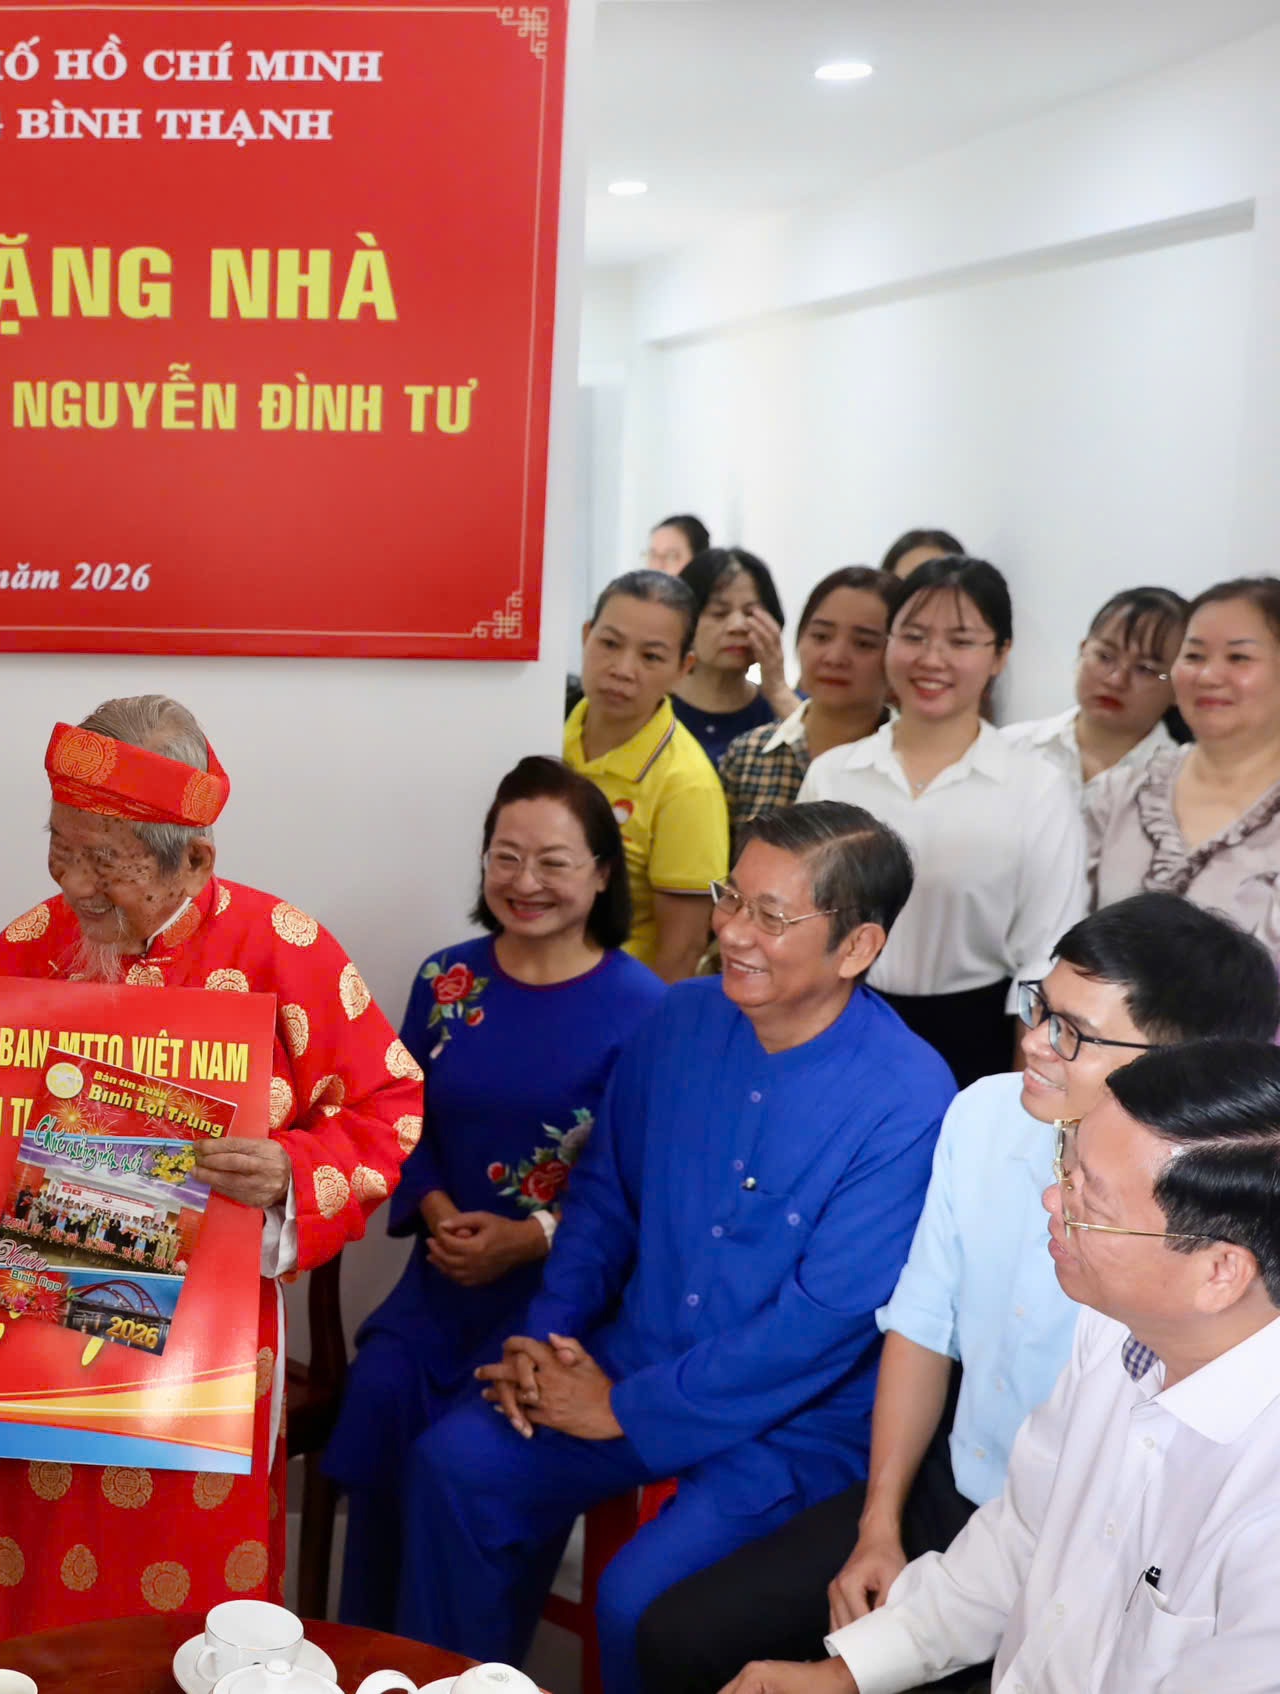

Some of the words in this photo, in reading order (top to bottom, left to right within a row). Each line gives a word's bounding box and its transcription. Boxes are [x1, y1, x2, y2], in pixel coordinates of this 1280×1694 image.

[54, 33, 128, 81] HỒ
[143, 41, 233, 81] CHÍ
[246, 50, 384, 82] MINH
[17, 99, 142, 139] BÌNH
[155, 109, 334, 147] THẠNH
[209, 231, 398, 321] NHÀ
[13, 362, 237, 430] NGUYỄN
[257, 372, 383, 433] ĐÌNH
[403, 378, 479, 434] TƯ
[71, 562, 151, 591] 2026
[190, 1040, 248, 1082] NAM
[167, 1105, 224, 1138] Trung
[106, 1316, 159, 1349] 2026
